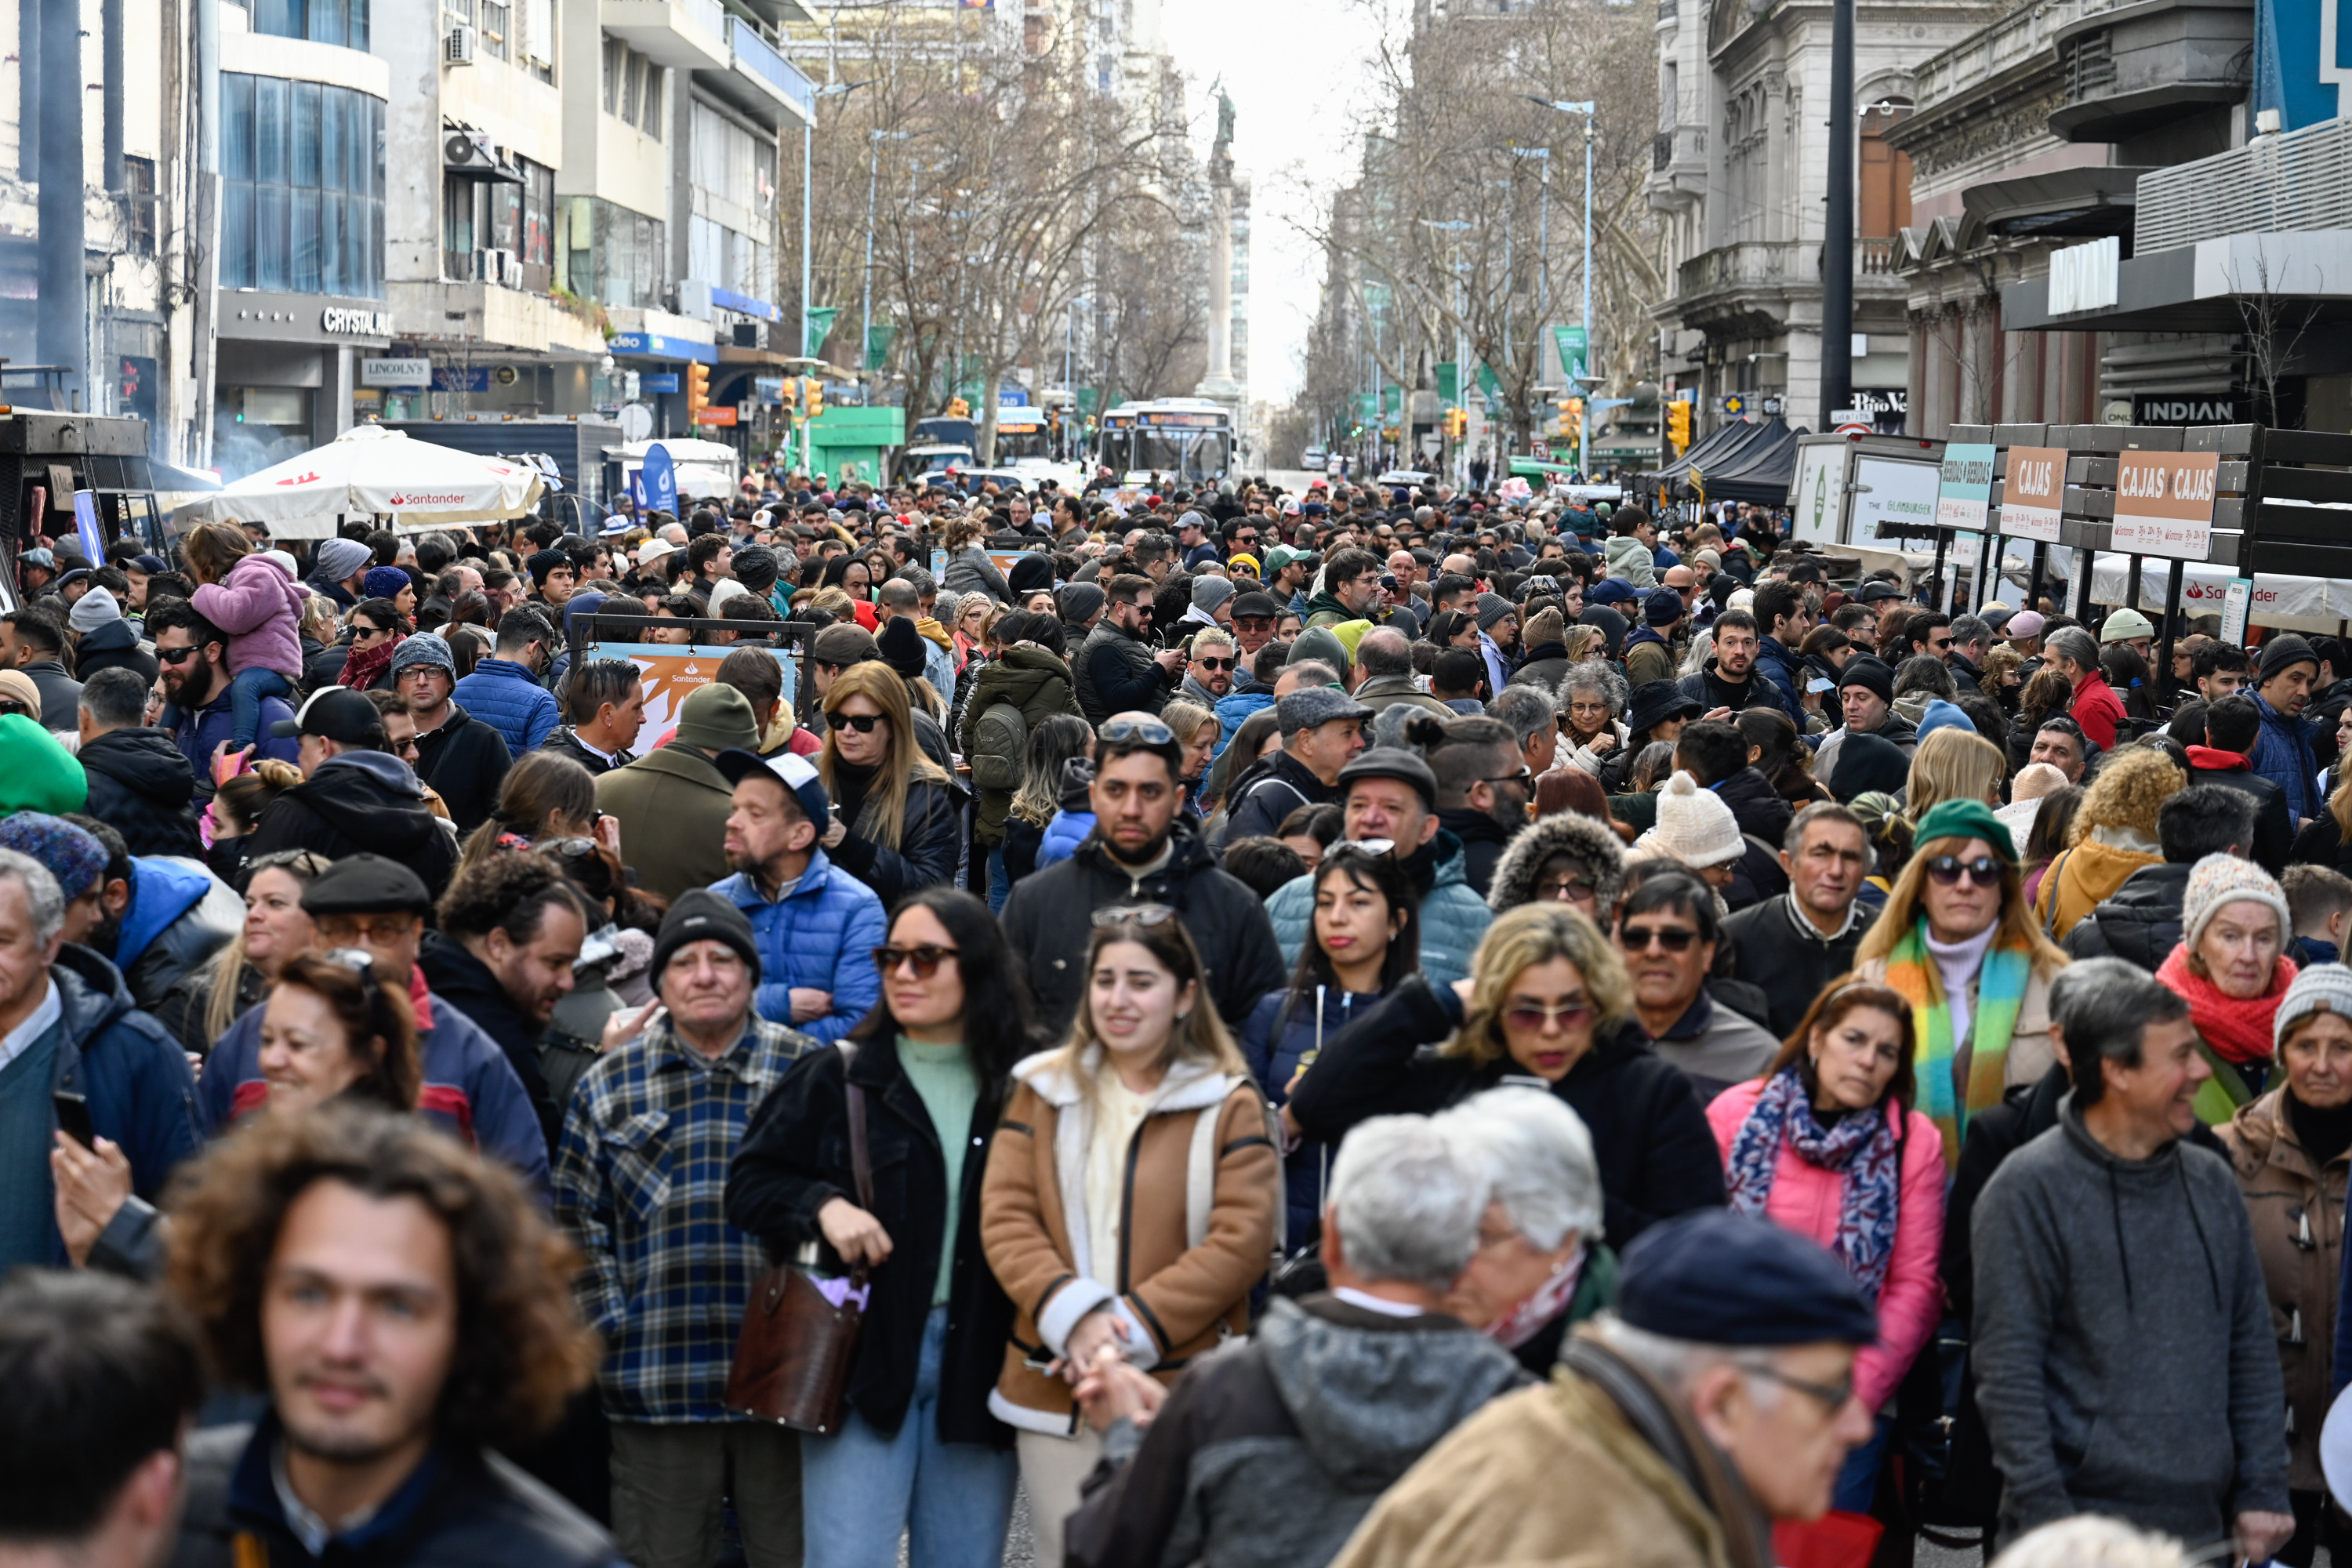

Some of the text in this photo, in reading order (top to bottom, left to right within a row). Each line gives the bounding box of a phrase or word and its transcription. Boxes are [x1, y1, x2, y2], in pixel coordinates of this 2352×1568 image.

[322, 306, 376, 334] CRYSTAL
[368, 362, 424, 375] LINCOLN'S
[2143, 401, 2233, 421] INDIAN
[1943, 459, 1963, 484] BEBIDAS
[1966, 460, 1991, 485] BEBIDAS
[2018, 459, 2052, 496] CAJAS
[2120, 466, 2214, 502] CAJAS CAJAS
[406, 494, 465, 504] Santander
[1887, 500, 1932, 515] GLAMBURGER
[2205, 586, 2278, 602] Sander
[672, 674, 711, 684] Santander
